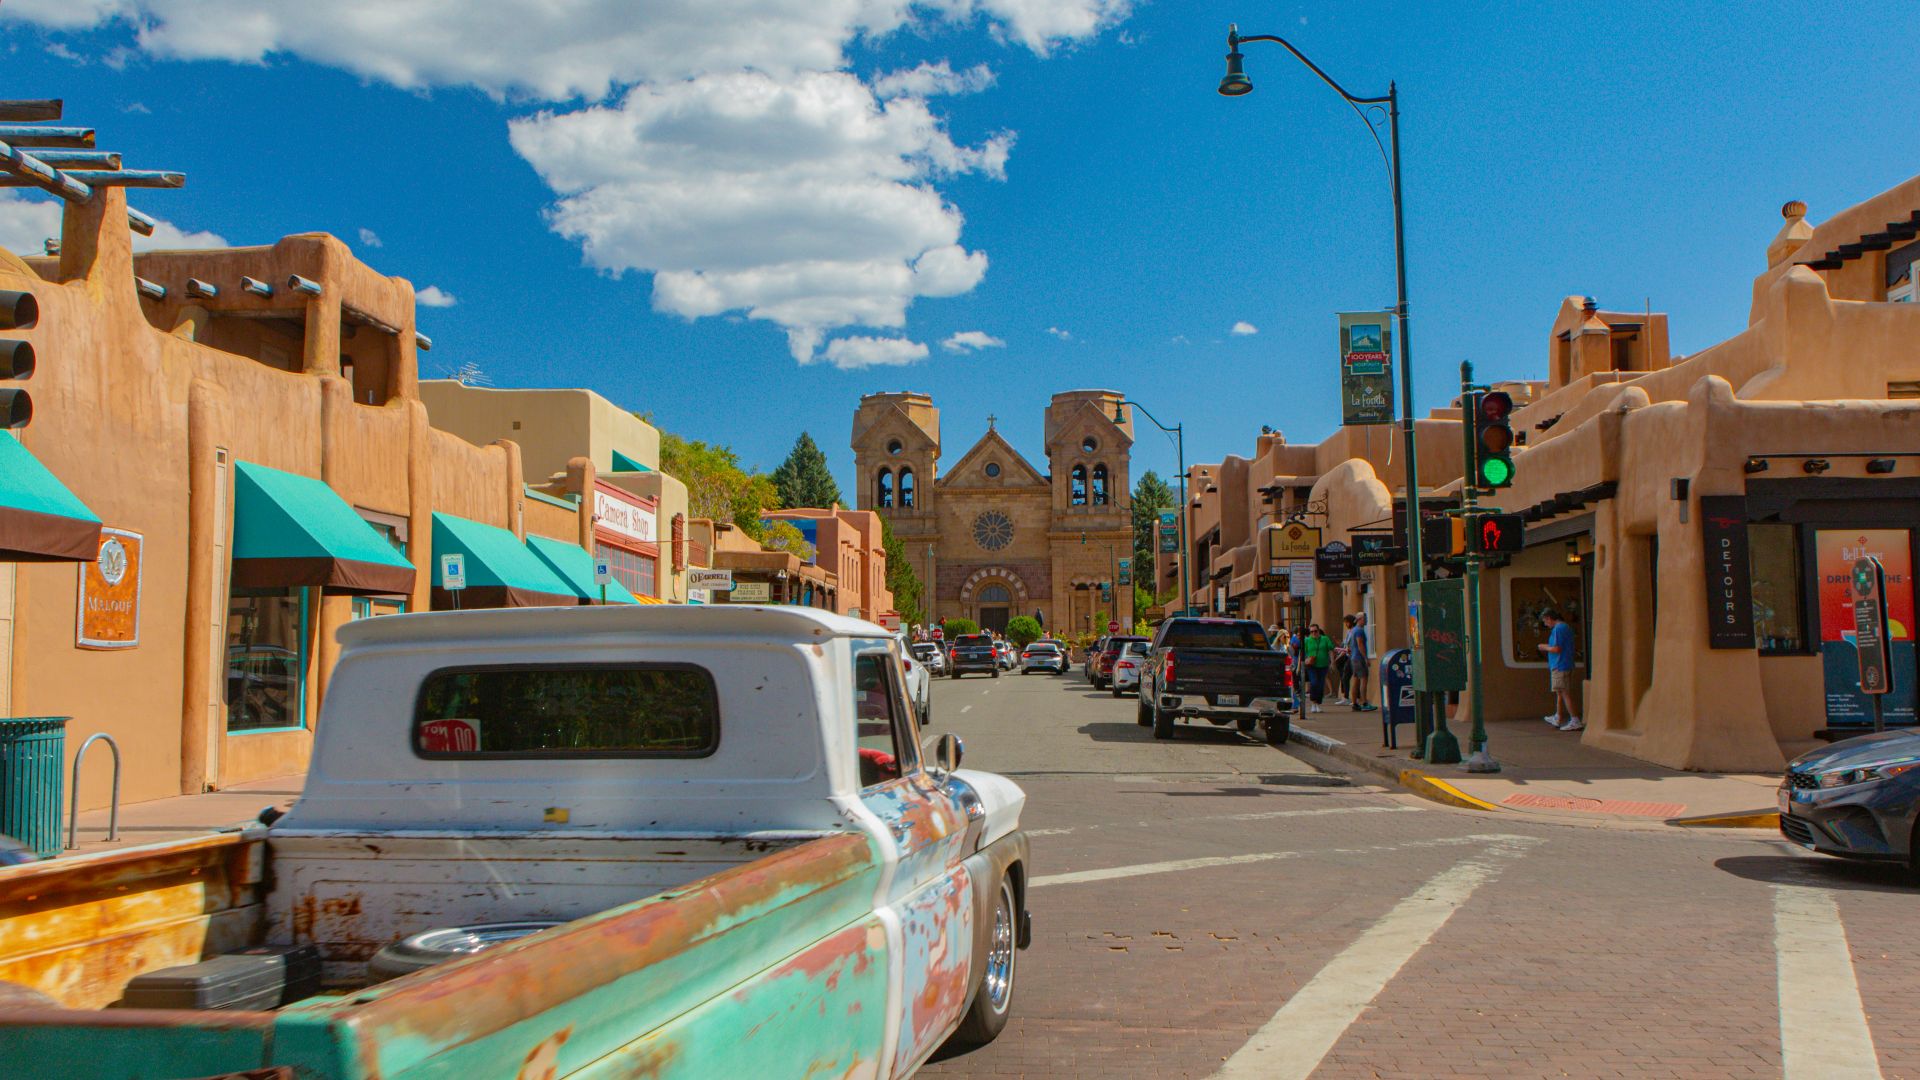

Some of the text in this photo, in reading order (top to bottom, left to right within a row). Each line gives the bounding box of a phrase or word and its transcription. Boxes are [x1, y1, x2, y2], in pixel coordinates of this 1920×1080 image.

[1351, 393, 1385, 408] La Fonda
[598, 494, 649, 540] Camera Shop
[1281, 541, 1310, 552] La Fonda
[1843, 546, 1858, 560] Bell
[1721, 539, 1736, 624] DETOURS
[1827, 575, 1852, 583] DRIN
